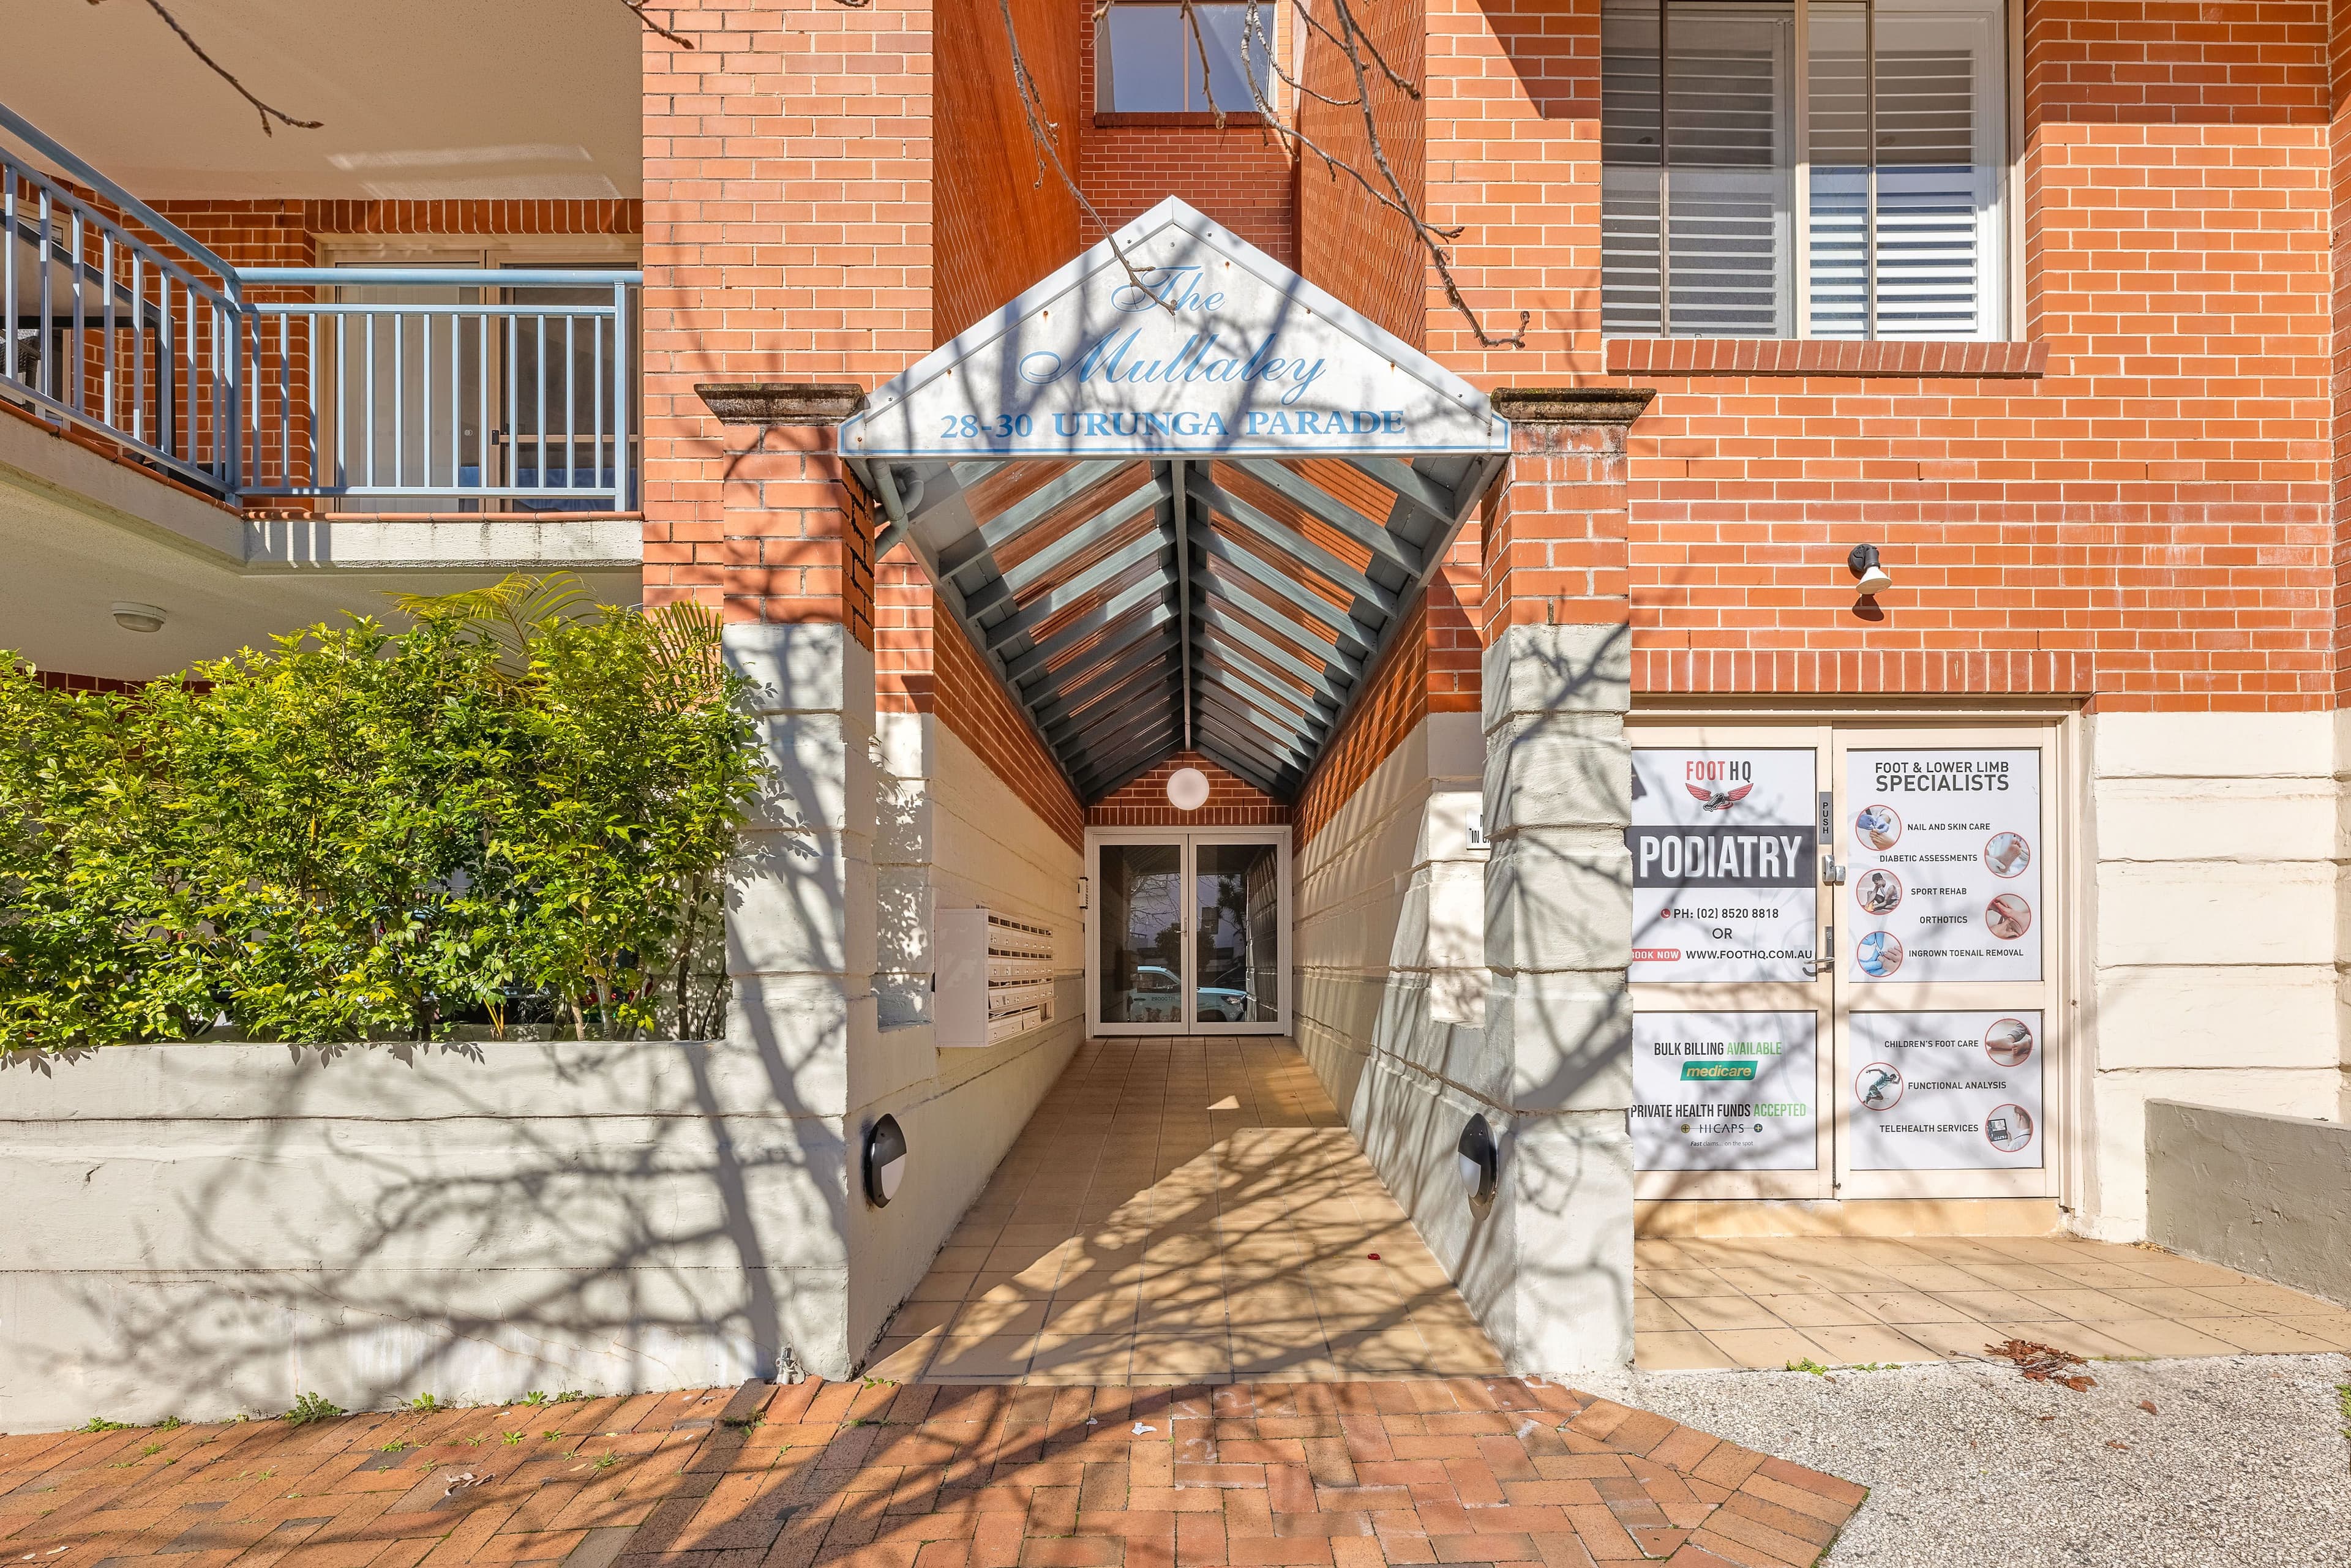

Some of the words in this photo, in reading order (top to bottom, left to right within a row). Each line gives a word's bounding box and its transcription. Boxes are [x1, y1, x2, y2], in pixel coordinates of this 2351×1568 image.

[1110, 265, 1224, 313] The
[1019, 328, 1326, 405] Mullaley
[940, 413, 1033, 438] 28-30
[1052, 411, 1231, 437] URUNGA
[1247, 410, 1406, 435] PARADE
[1686, 761, 1725, 781] FOOT
[1730, 761, 1751, 782] HQ
[1875, 762, 1908, 773] FOOT
[1913, 762, 1922, 773] &
[1927, 762, 1973, 773] LOWER
[1976, 762, 2009, 773] LIMB
[1875, 774, 2009, 792] SPECIALISTS
[1640, 836, 1802, 878] PODIATRY
[1674, 909, 1693, 918] PH:
[1697, 909, 1718, 920] (02)
[1722, 909, 1749, 918] 8520
[1752, 909, 1779, 918] 8818
[1712, 928, 1733, 939] OR
[1686, 950, 1812, 959] WWW.FOOTHQ.COM.AU
[1654, 1042, 1681, 1056] BULK
[1684, 1042, 1723, 1056] BILLING
[1727, 1042, 1782, 1055] AVAILABLE
[1686, 1065, 1751, 1078] medicare
[1630, 1104, 1673, 1117] PRIVATE
[1676, 1104, 1714, 1117] HEALTH
[1717, 1104, 1750, 1117] FUNDS
[1753, 1103, 1806, 1117] ACCEPTED
[1700, 1123, 1744, 1133] HICAPS
